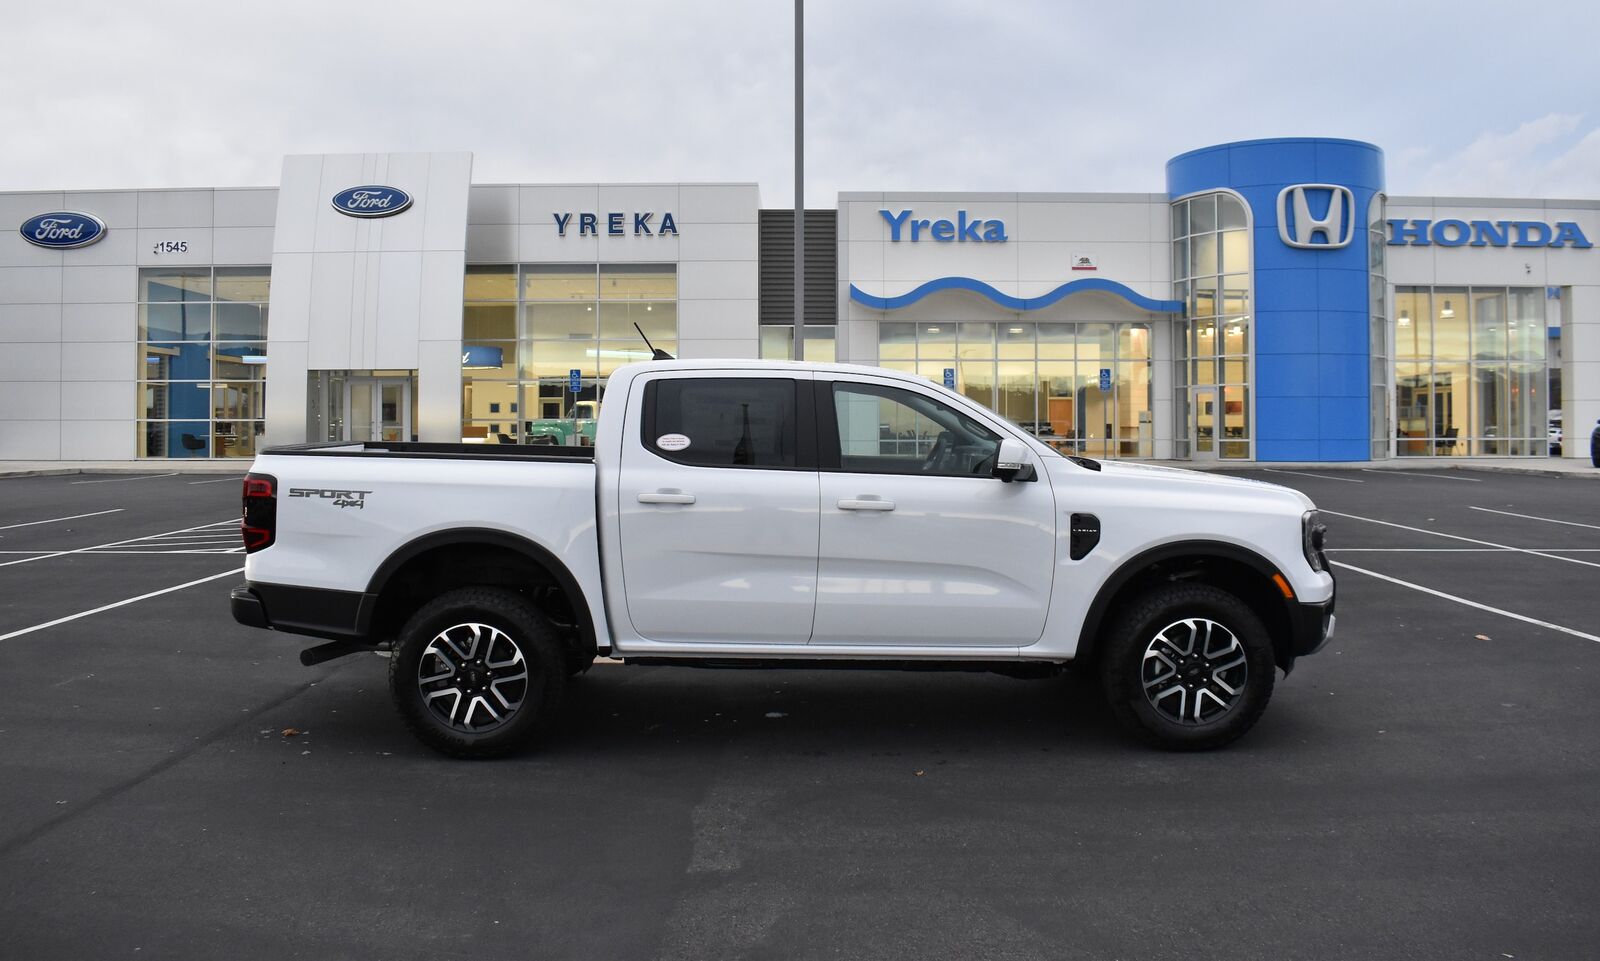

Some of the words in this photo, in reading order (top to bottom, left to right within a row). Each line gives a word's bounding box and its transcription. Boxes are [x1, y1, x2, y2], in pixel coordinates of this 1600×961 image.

[347, 190, 393, 208] Ford
[35, 218, 84, 239] Ford
[553, 212, 680, 236] YREKA
[878, 209, 1009, 242] Yreka
[1386, 218, 1593, 248] HONDA
[159, 241, 188, 253] 1545
[288, 488, 374, 500] SPORT
